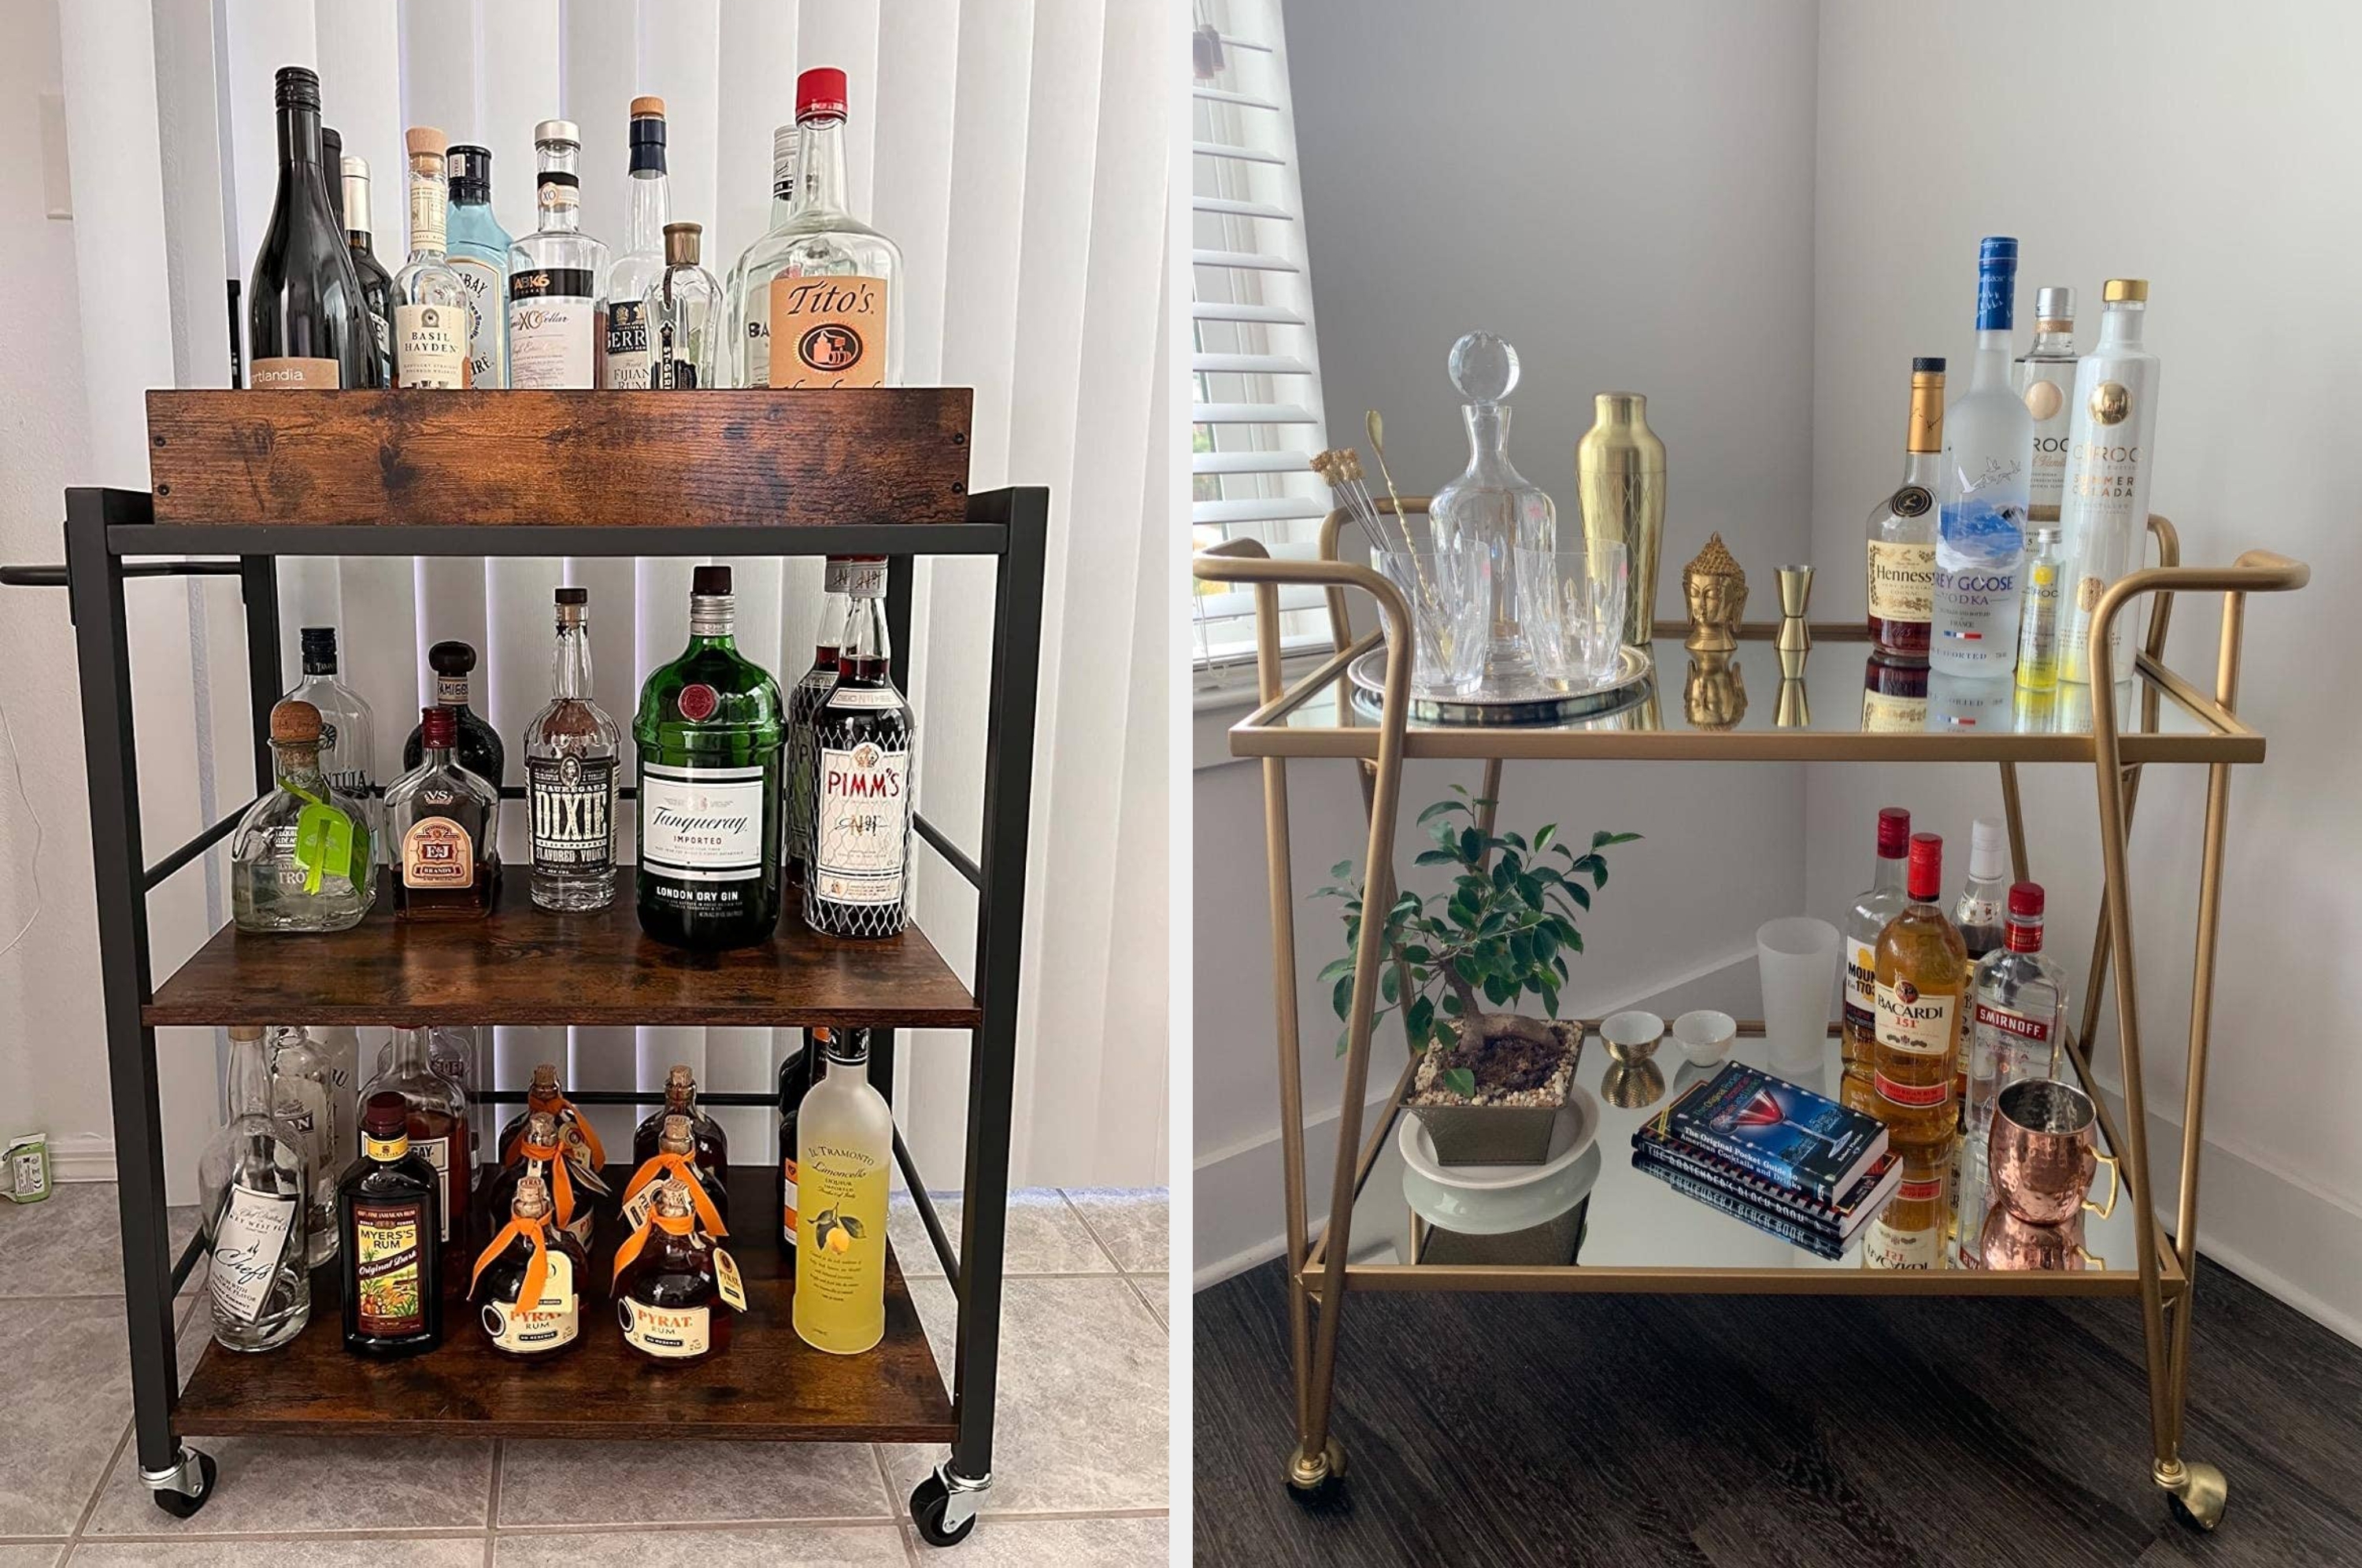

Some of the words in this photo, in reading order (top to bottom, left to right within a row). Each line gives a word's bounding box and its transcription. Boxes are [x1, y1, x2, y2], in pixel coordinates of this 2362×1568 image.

[514, 273, 550, 290] ABK6
[787, 280, 874, 316] Tito's
[411, 331, 450, 342] BASIL
[749, 322, 770, 338] BA
[405, 342, 457, 353] HAYDEN
[1958, 574, 2013, 591] GOOSE
[1941, 593, 1989, 606] VODKA
[827, 767, 900, 797] PIMM'S
[426, 790, 449, 801] VS
[535, 790, 607, 841] DIXIE
[653, 806, 748, 835] Tanqueray
[673, 835, 722, 845] IMPORTED
[536, 846, 576, 862] FLAVORED
[580, 847, 607, 862] VODKA
[657, 886, 693, 900] LONDON
[697, 892, 718, 901] DRY
[721, 891, 739, 900] GIN
[1878, 994, 1943, 1019] BACARDI
[1896, 1016, 1916, 1028] 151
[1980, 1008, 2041, 1037] SMIRNOFF
[818, 1146, 875, 1167] TRAMONTO
[1684, 1126, 1699, 1139] The
[1700, 1130, 1733, 1152] Original
[1734, 1148, 1760, 1164] Pocket
[1763, 1160, 1786, 1175] Guide
[813, 1161, 866, 1178] Limoncello
[1680, 1133, 1716, 1154] American
[1717, 1148, 1754, 1170] Cocktails
[1756, 1167, 1772, 1178] and
[1773, 1172, 1802, 1191] Drinks
[361, 1229, 414, 1241] MYERS'S
[373, 1240, 401, 1249] RUM
[359, 1261, 393, 1276] Original
[394, 1248, 419, 1267] Dark
[525, 1322, 550, 1330] RUM
[638, 1308, 693, 1329] PYRAT
[651, 1326, 676, 1336] RUM
